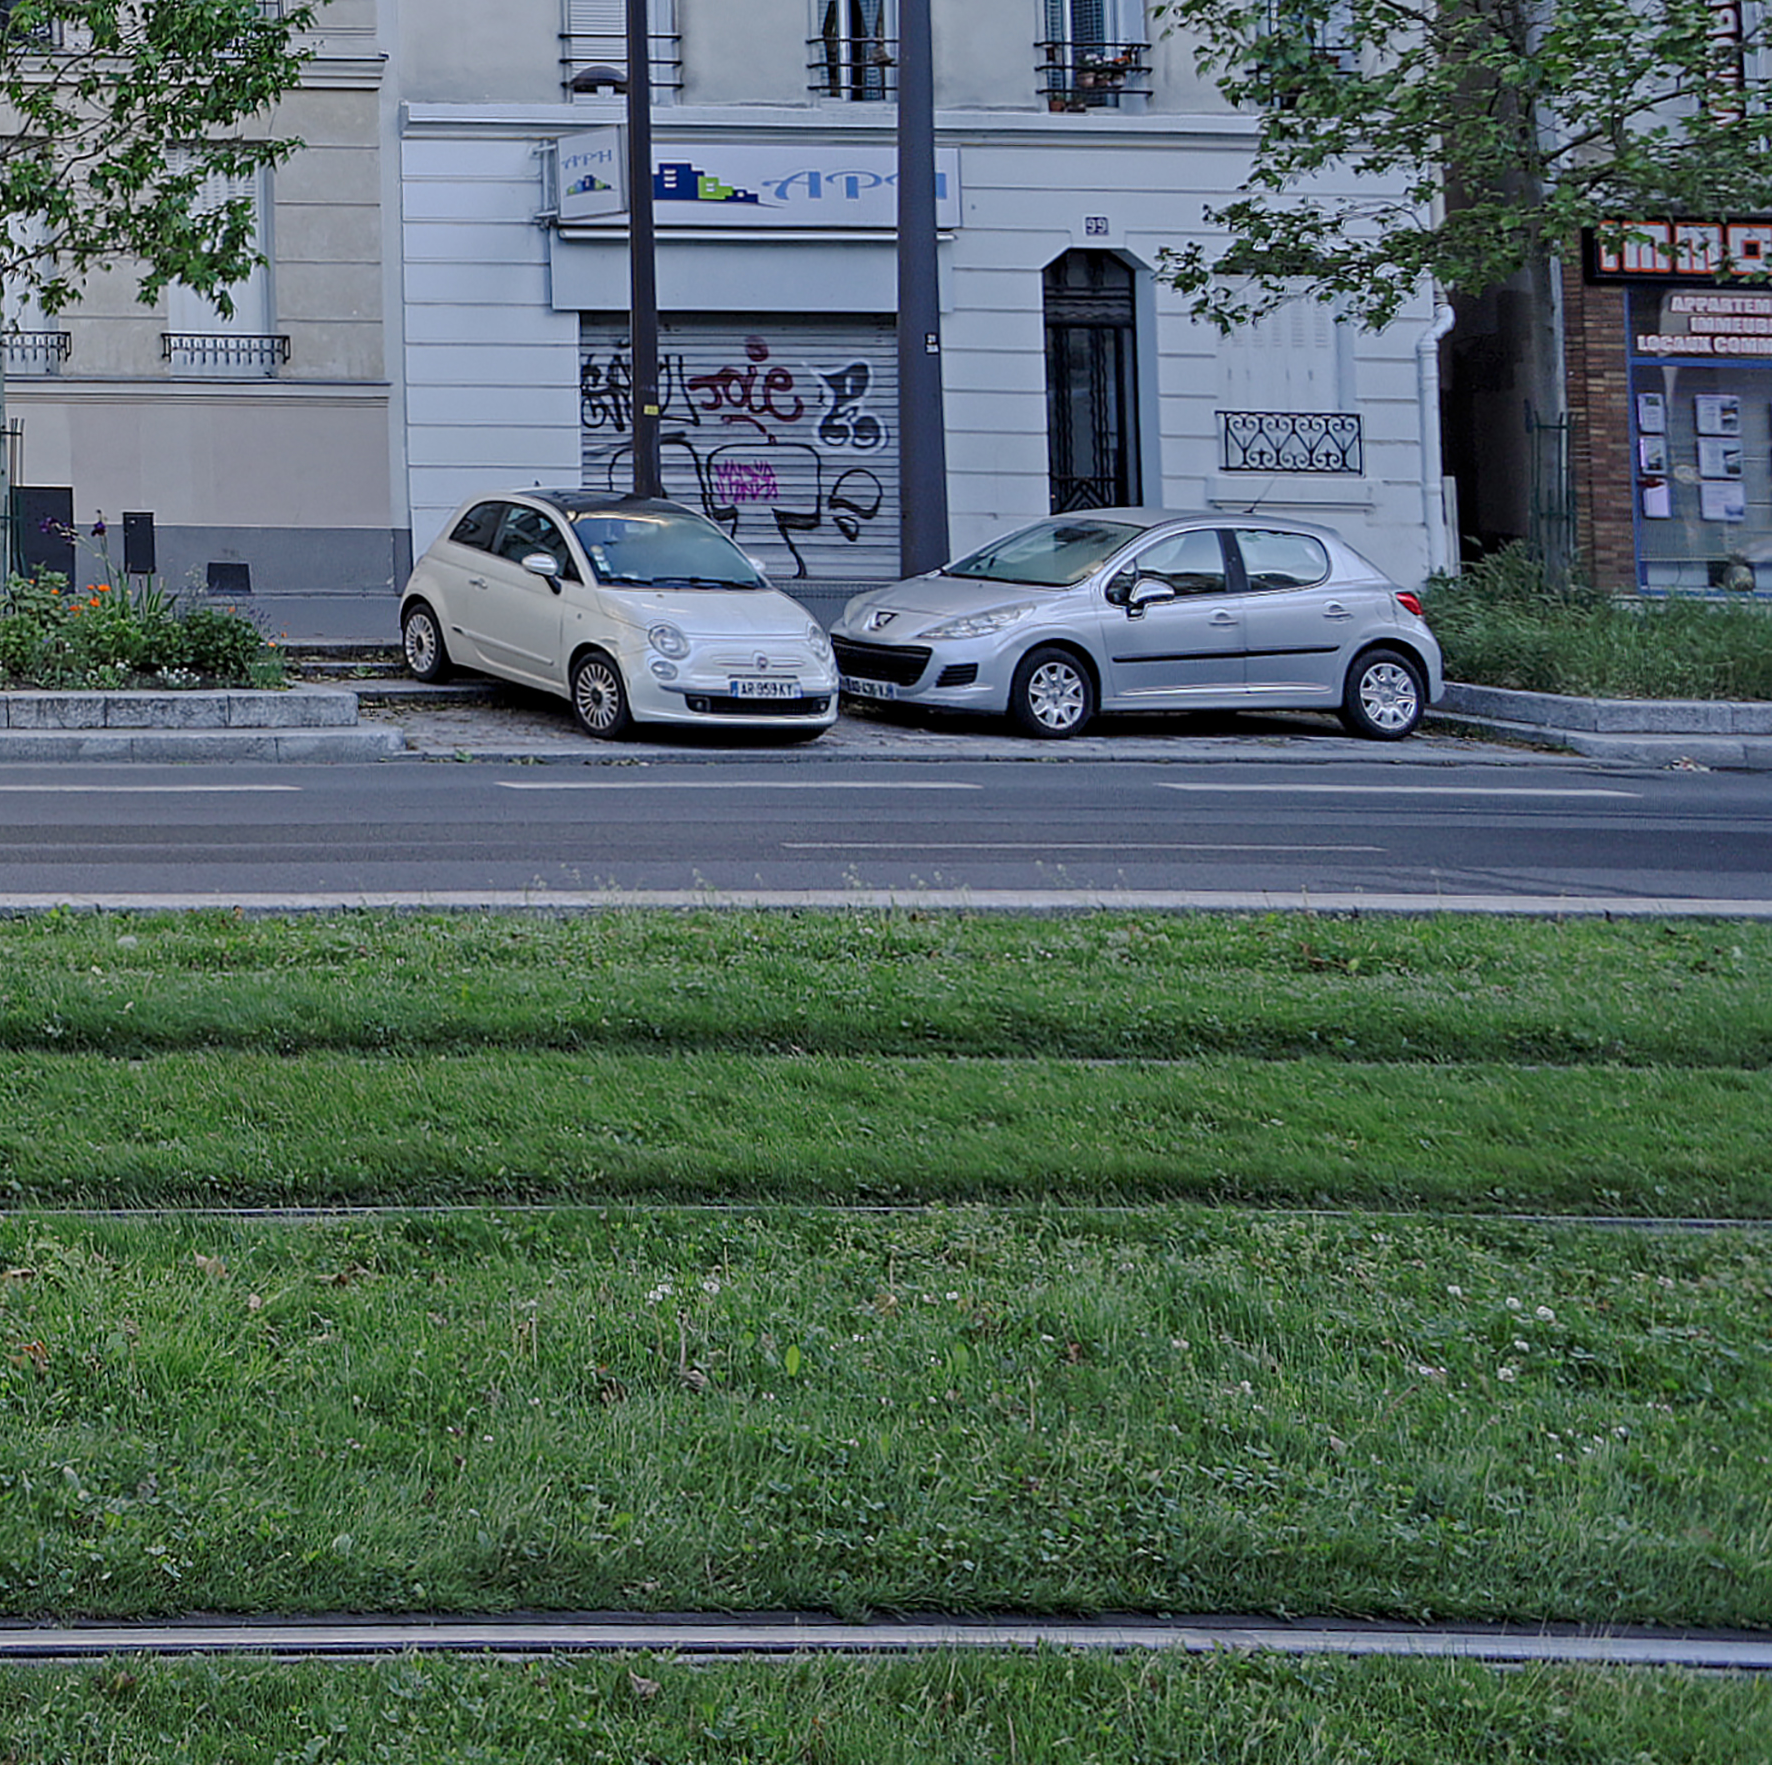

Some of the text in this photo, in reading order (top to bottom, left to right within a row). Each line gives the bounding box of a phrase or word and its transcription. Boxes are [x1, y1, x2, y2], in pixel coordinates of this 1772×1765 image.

[561, 149, 612, 170] APH
[1087, 218, 1106, 233] 99
[1637, 334, 1712, 353] LOCAUX
